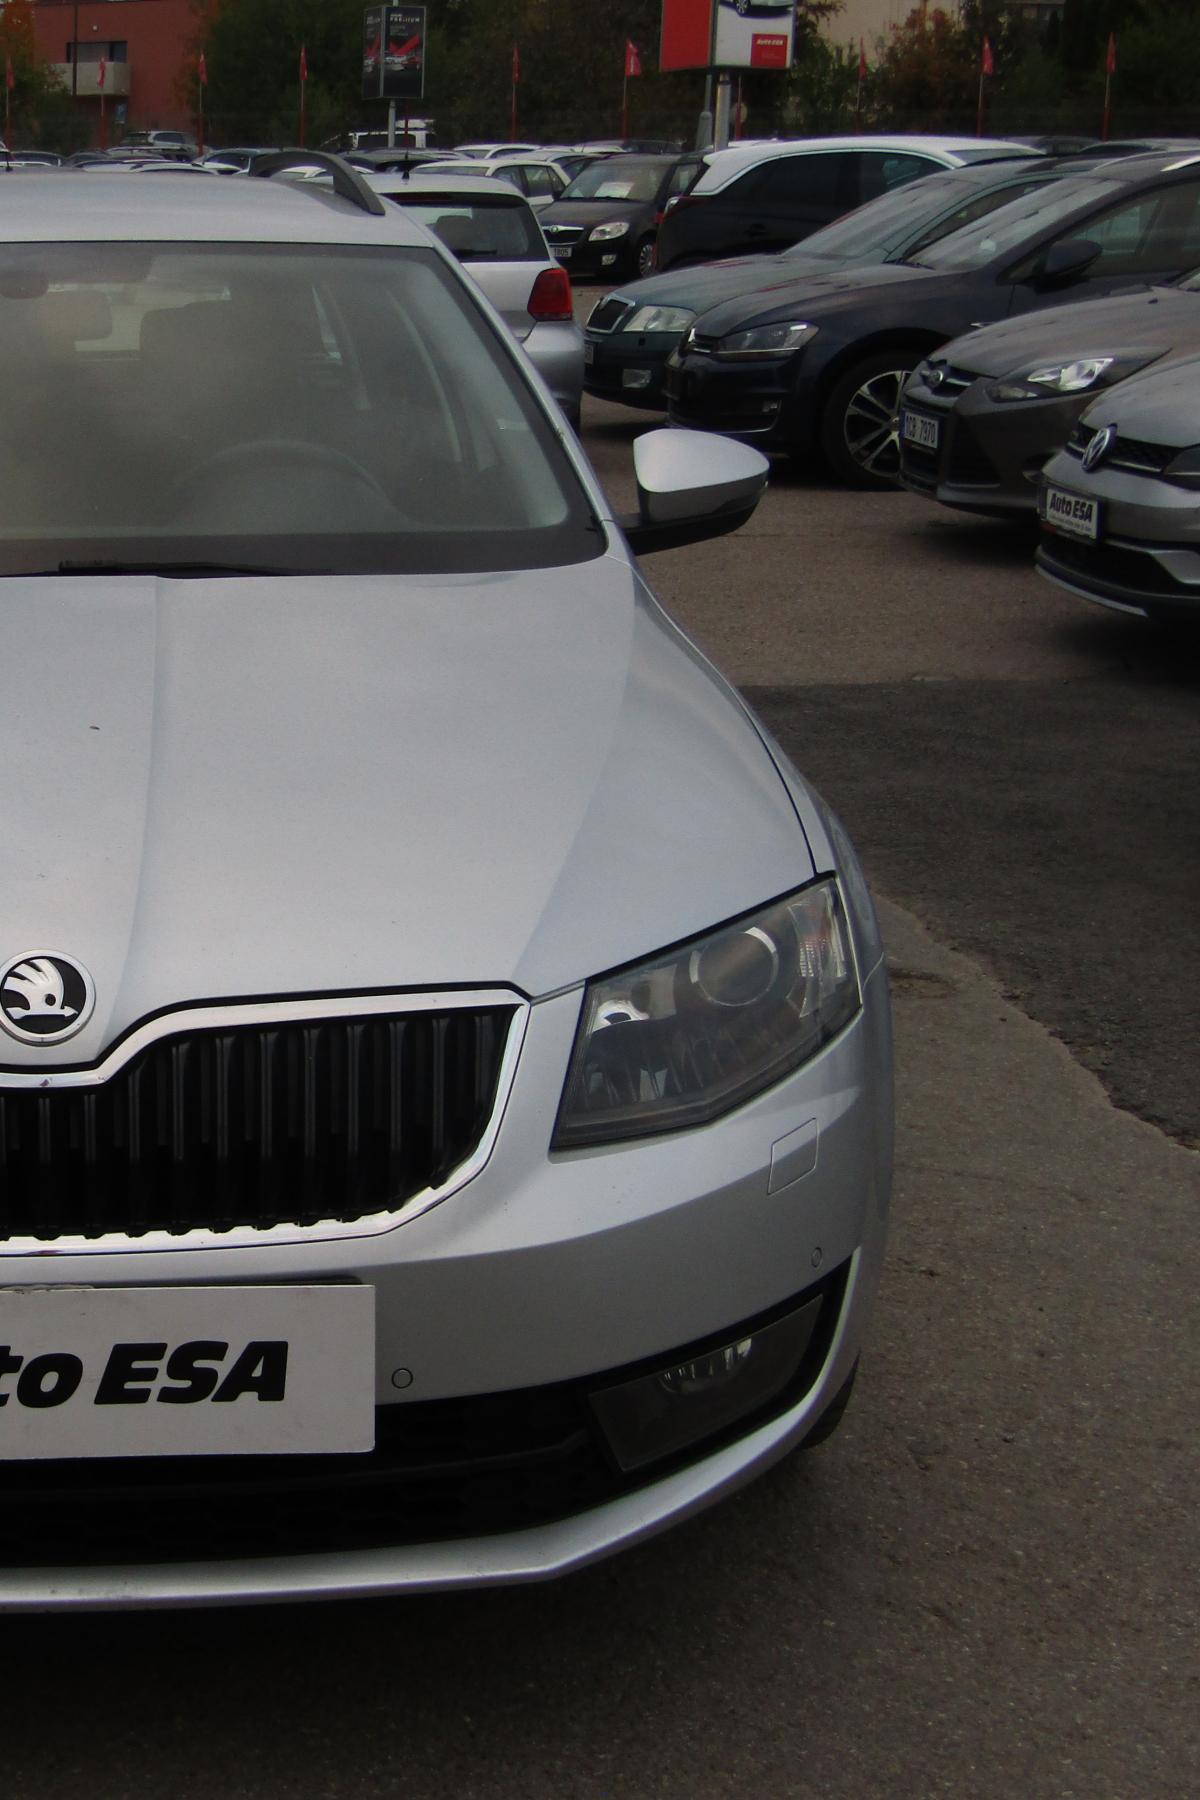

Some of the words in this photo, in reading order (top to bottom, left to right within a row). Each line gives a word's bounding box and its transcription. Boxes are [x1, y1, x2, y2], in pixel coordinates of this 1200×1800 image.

[1049, 492, 1073, 517] Auto
[1072, 499, 1094, 523] ESA
[93, 1340, 289, 1406] ESA
